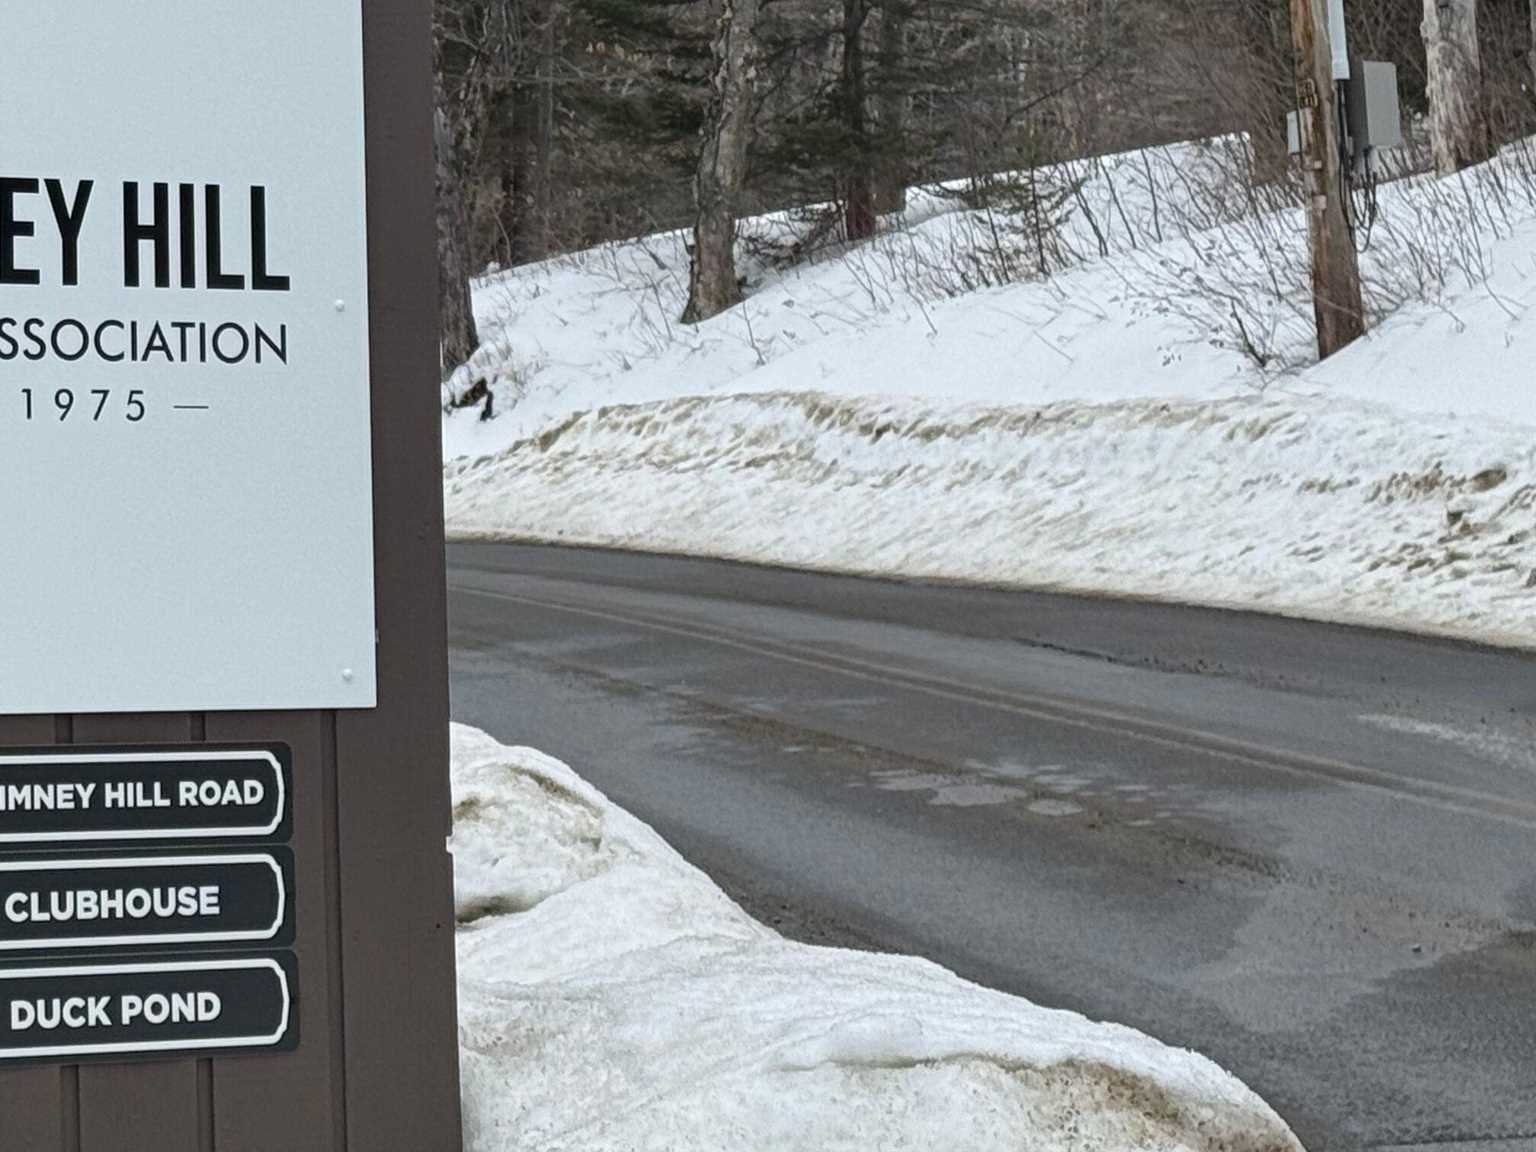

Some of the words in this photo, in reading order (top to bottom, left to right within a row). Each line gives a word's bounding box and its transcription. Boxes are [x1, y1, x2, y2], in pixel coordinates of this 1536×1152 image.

[121, 180, 291, 292] HILL
[20, 388, 146, 422] 1975
[104, 781, 172, 809] HILL
[178, 779, 265, 808] ROAD
[4, 885, 221, 923] CLUBHOUSE
[9, 995, 112, 1031] DUCK
[120, 991, 222, 1026] POND
